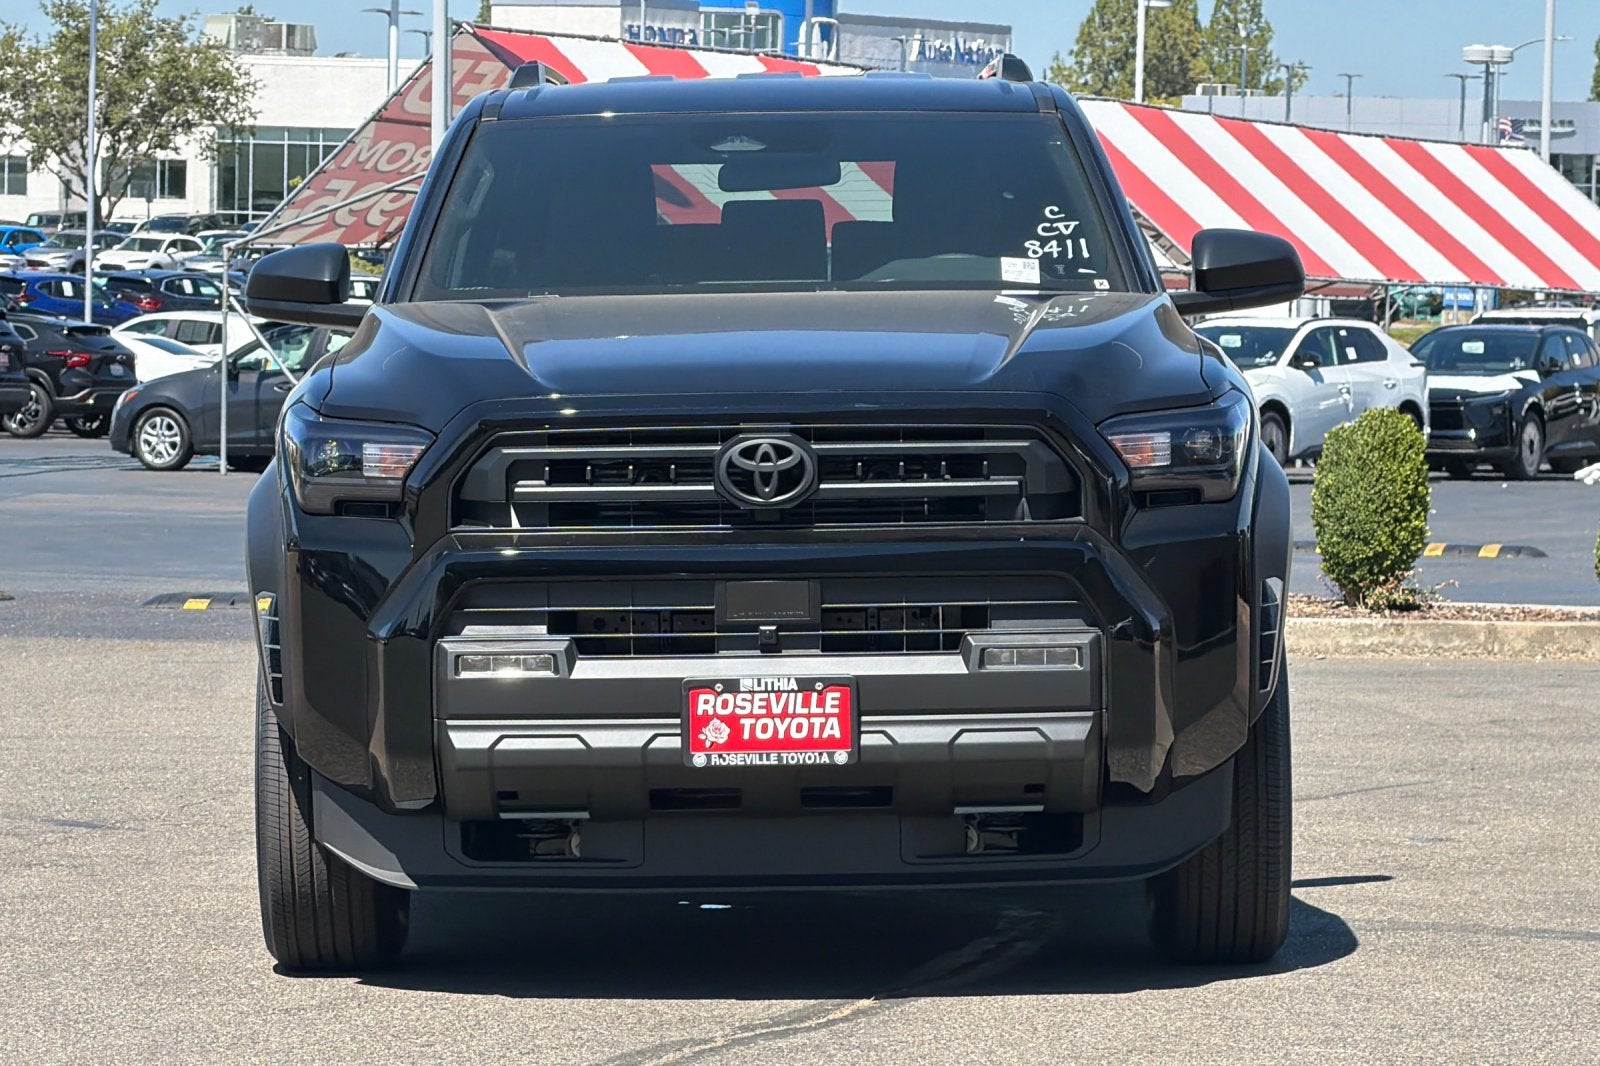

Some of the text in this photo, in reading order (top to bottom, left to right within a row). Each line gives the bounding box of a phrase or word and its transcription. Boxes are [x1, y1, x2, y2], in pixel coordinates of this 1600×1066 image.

[627, 24, 699, 45] HONDA
[1024, 238, 1090, 259] 8411
[753, 677, 799, 692] LITHIA
[697, 691, 842, 716] ROSEVILLE
[739, 717, 842, 740] TOYOTA
[711, 752, 830, 766] ROSEVILLE TOYOTA
